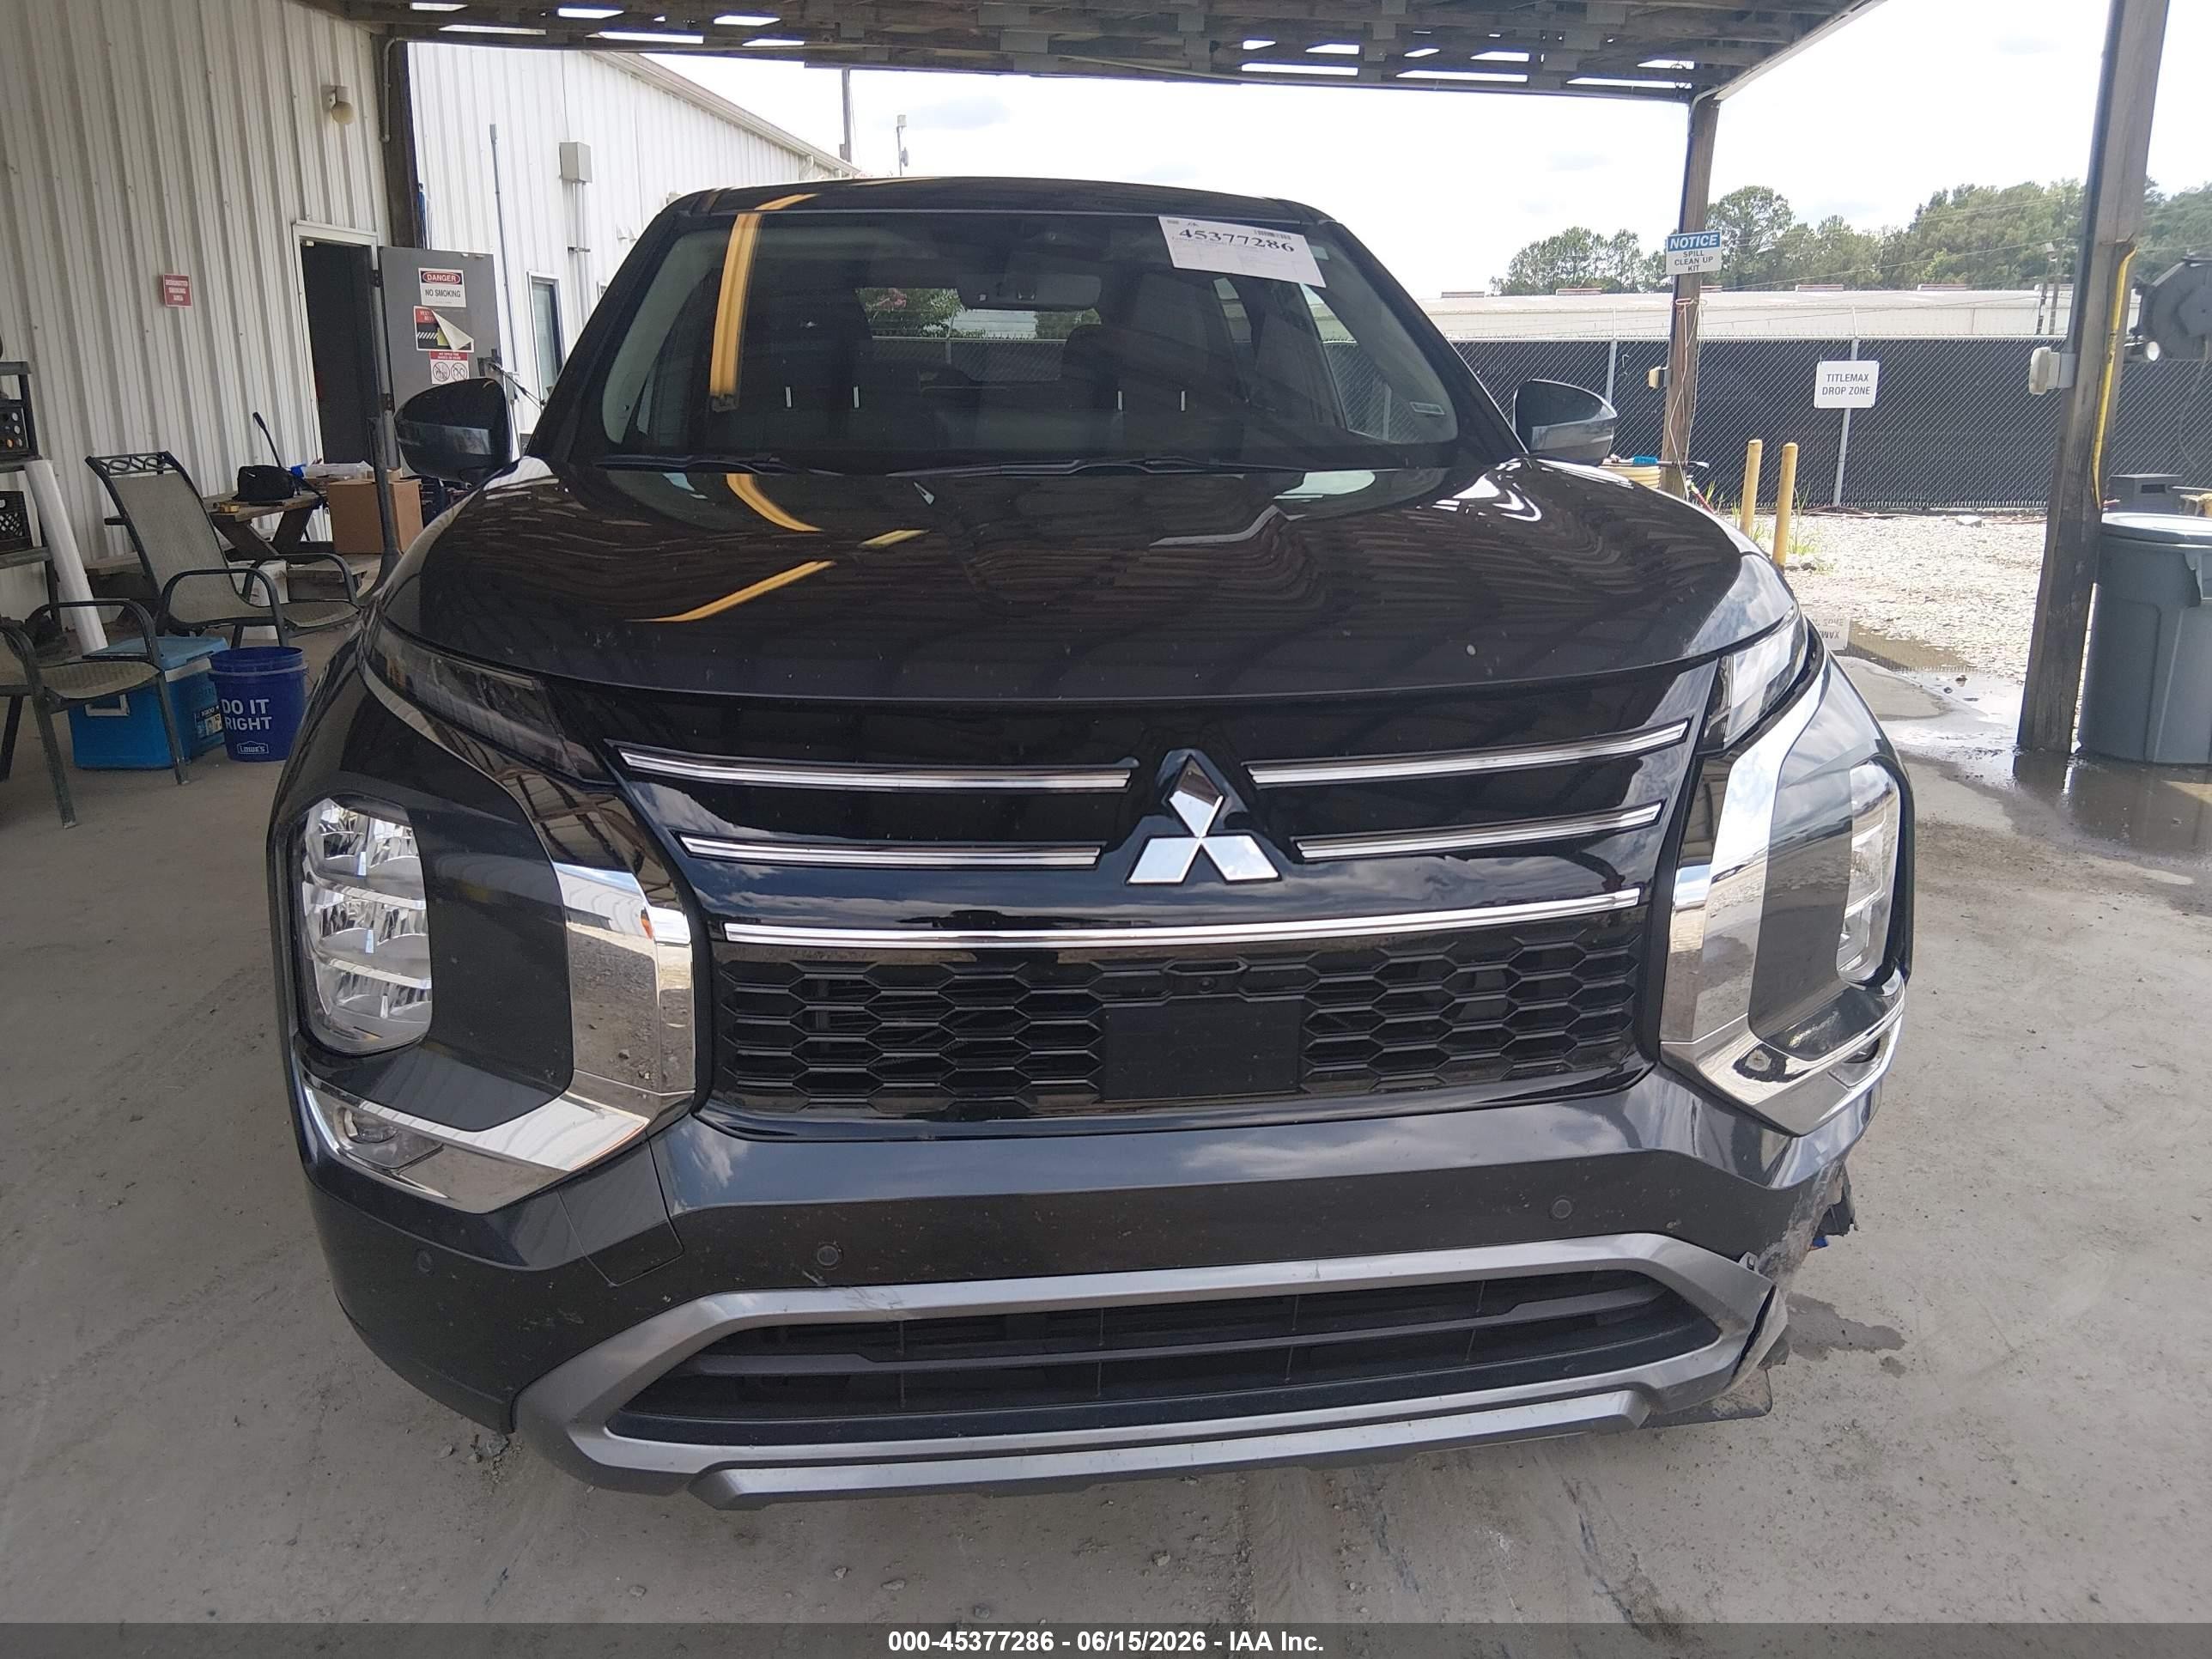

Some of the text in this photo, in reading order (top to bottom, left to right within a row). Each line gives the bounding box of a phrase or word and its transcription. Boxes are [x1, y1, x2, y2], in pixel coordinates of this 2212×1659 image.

[1179, 228, 1295, 252] 45377286
[1669, 234, 1718, 250] NOTICE
[1674, 258, 1699, 266] CLEAN
[427, 274, 457, 283] DANGER
[425, 288, 461, 298] NO SMOKING
[1826, 373, 1869, 383] TITLEMAX
[1822, 386, 1871, 396] DROP ZONE
[221, 698, 244, 715] DO
[249, 698, 270, 715] IT
[224, 716, 272, 731] RIGHT
